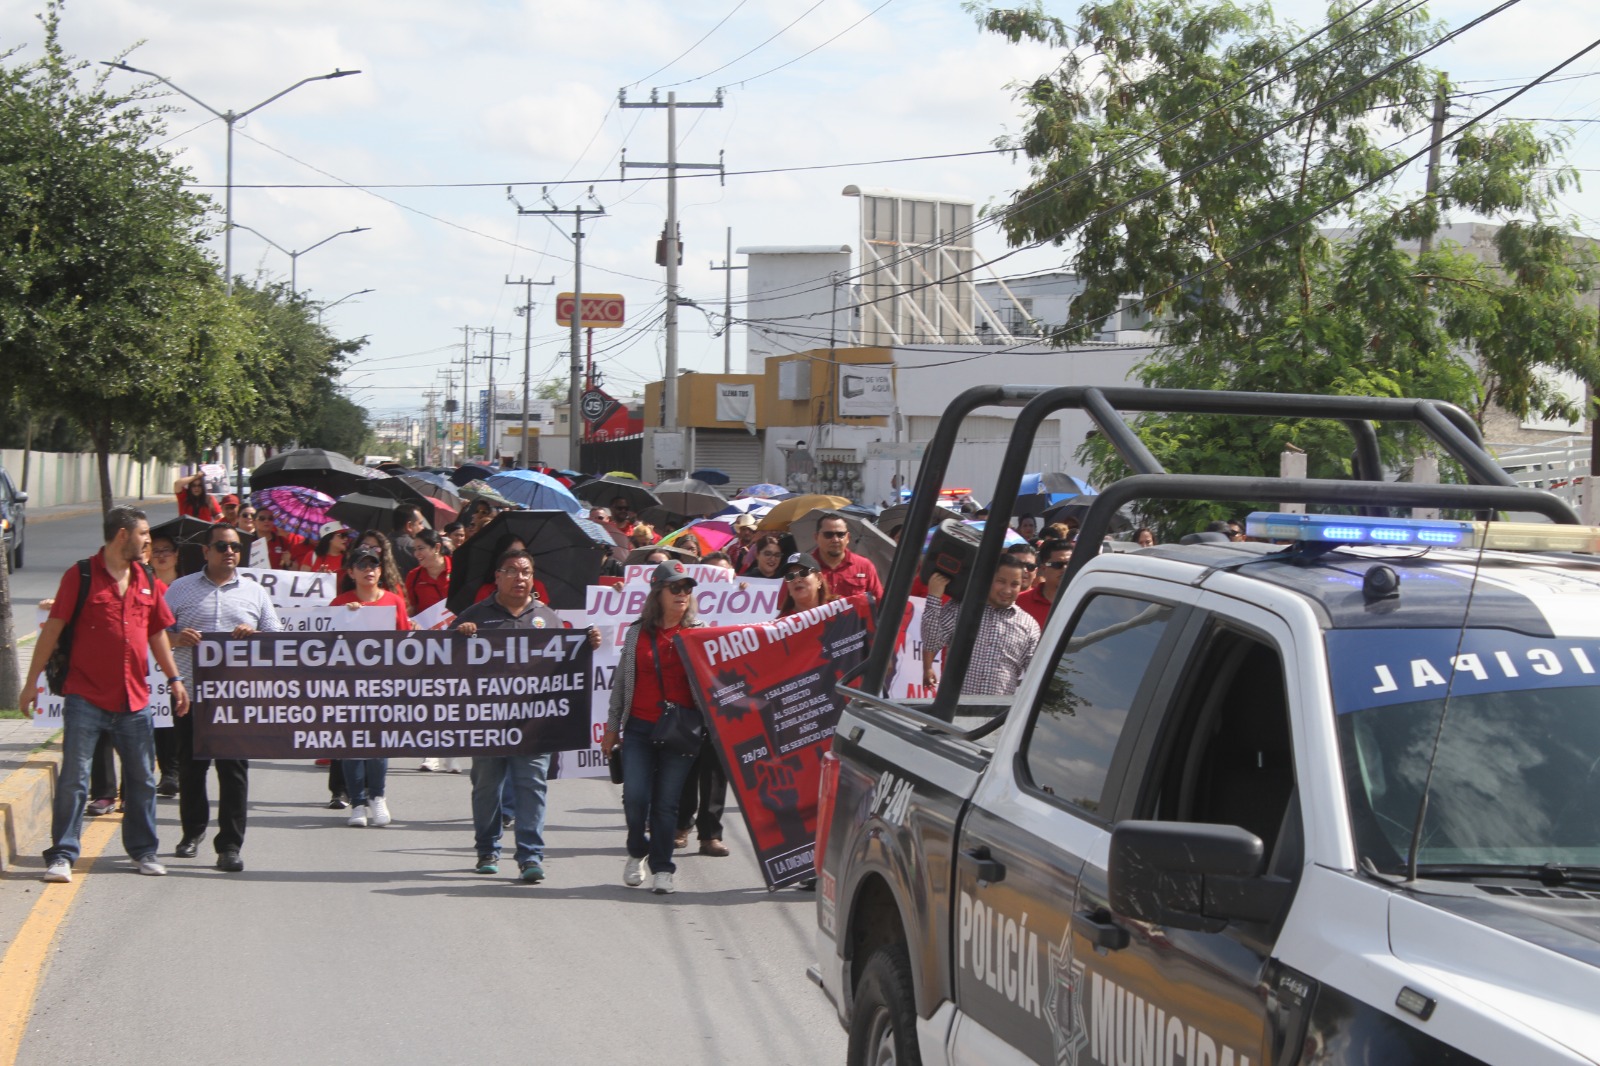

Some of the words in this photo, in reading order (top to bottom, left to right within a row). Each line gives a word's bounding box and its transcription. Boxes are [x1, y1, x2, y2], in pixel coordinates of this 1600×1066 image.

[560, 300, 622, 320] OXXO
[587, 401, 600, 411] JS
[625, 566, 654, 584] PO
[289, 576, 325, 598] LA
[298, 617, 311, 631] al
[703, 628, 760, 666] PARO
[762, 597, 854, 644] NACIONAL
[197, 632, 452, 667] DELEGACIÓN
[467, 634, 587, 665] D-II-47
[196, 680, 300, 702] ¡EXIGIMOS
[306, 679, 349, 698] UNA
[355, 678, 472, 698] RESPUESTA
[477, 673, 585, 695] FAVORABLE
[769, 681, 798, 699] SALARIO
[780, 688, 811, 705] DIRECTO
[213, 706, 239, 724] AL
[244, 705, 316, 723] PLIEGO
[322, 704, 427, 723] PETITORIO
[434, 704, 459, 721] DE
[465, 698, 570, 721] DEMANDAS
[783, 701, 809, 717] SUELDO
[820, 703, 834, 715] POR
[799, 721, 818, 734] AÑOS
[294, 731, 347, 749] PARA
[352, 730, 376, 748] EL
[381, 727, 523, 748] MAGISTERIO
[789, 733, 820, 751] SERVICIO
[741, 746, 768, 764] 28/30
[774, 861, 787, 874] LA
[960, 889, 1041, 1019] POLICÍA
